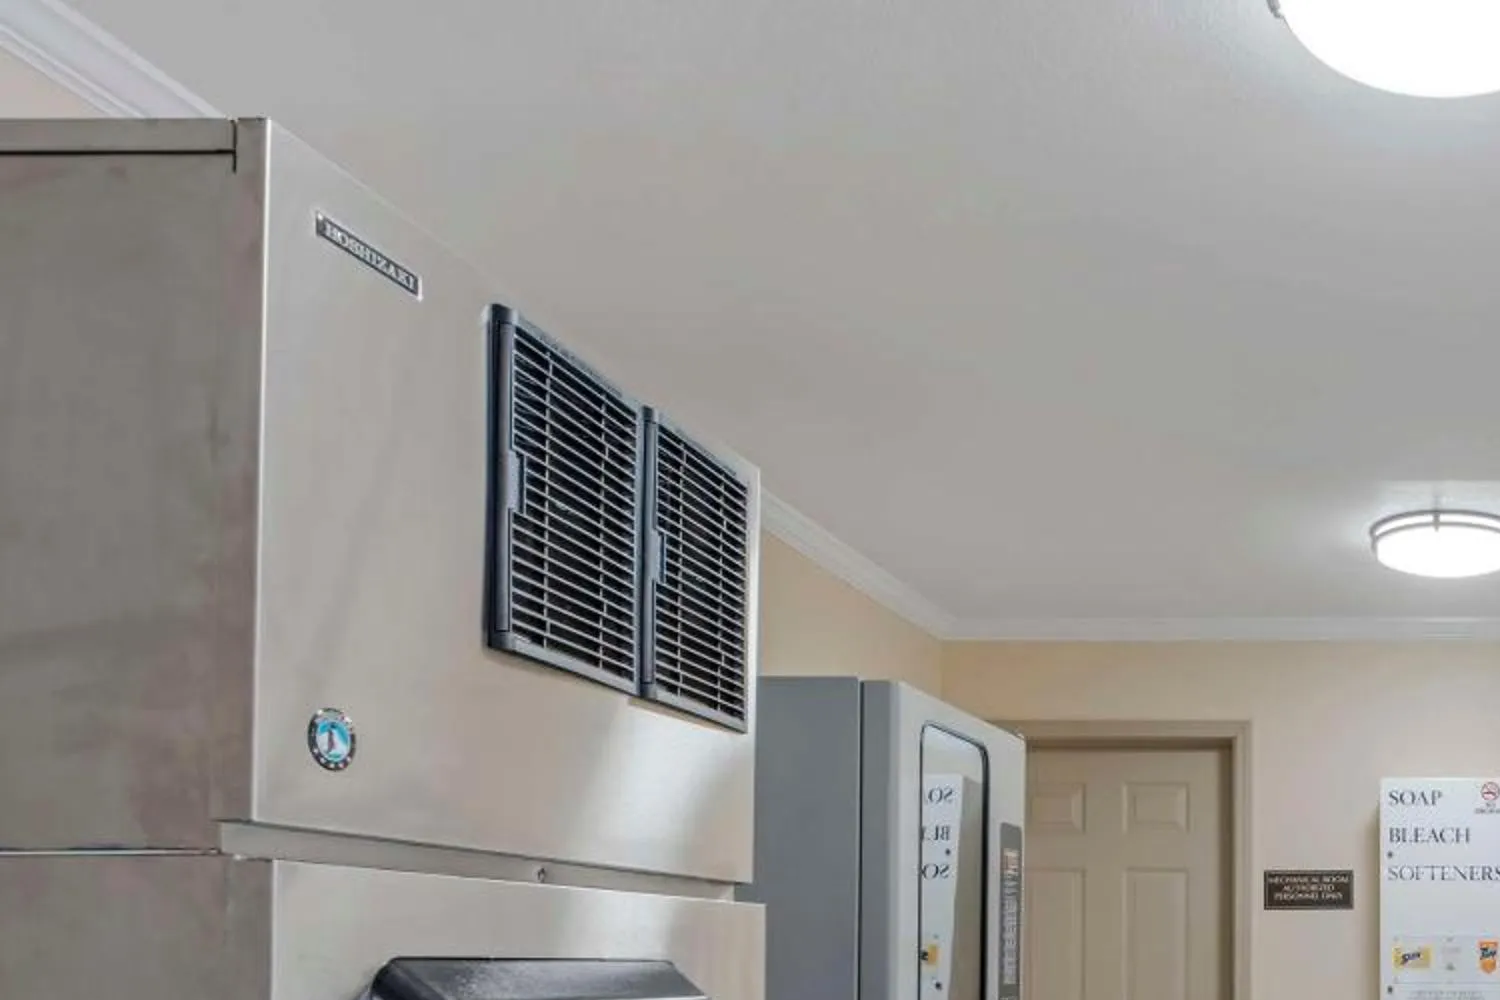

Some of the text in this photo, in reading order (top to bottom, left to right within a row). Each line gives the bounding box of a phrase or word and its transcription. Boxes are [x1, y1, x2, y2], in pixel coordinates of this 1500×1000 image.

[323, 220, 417, 292] HOSHIZAKI
[1388, 789, 1443, 807] SOAP
[1388, 826, 1472, 845] BLEACH
